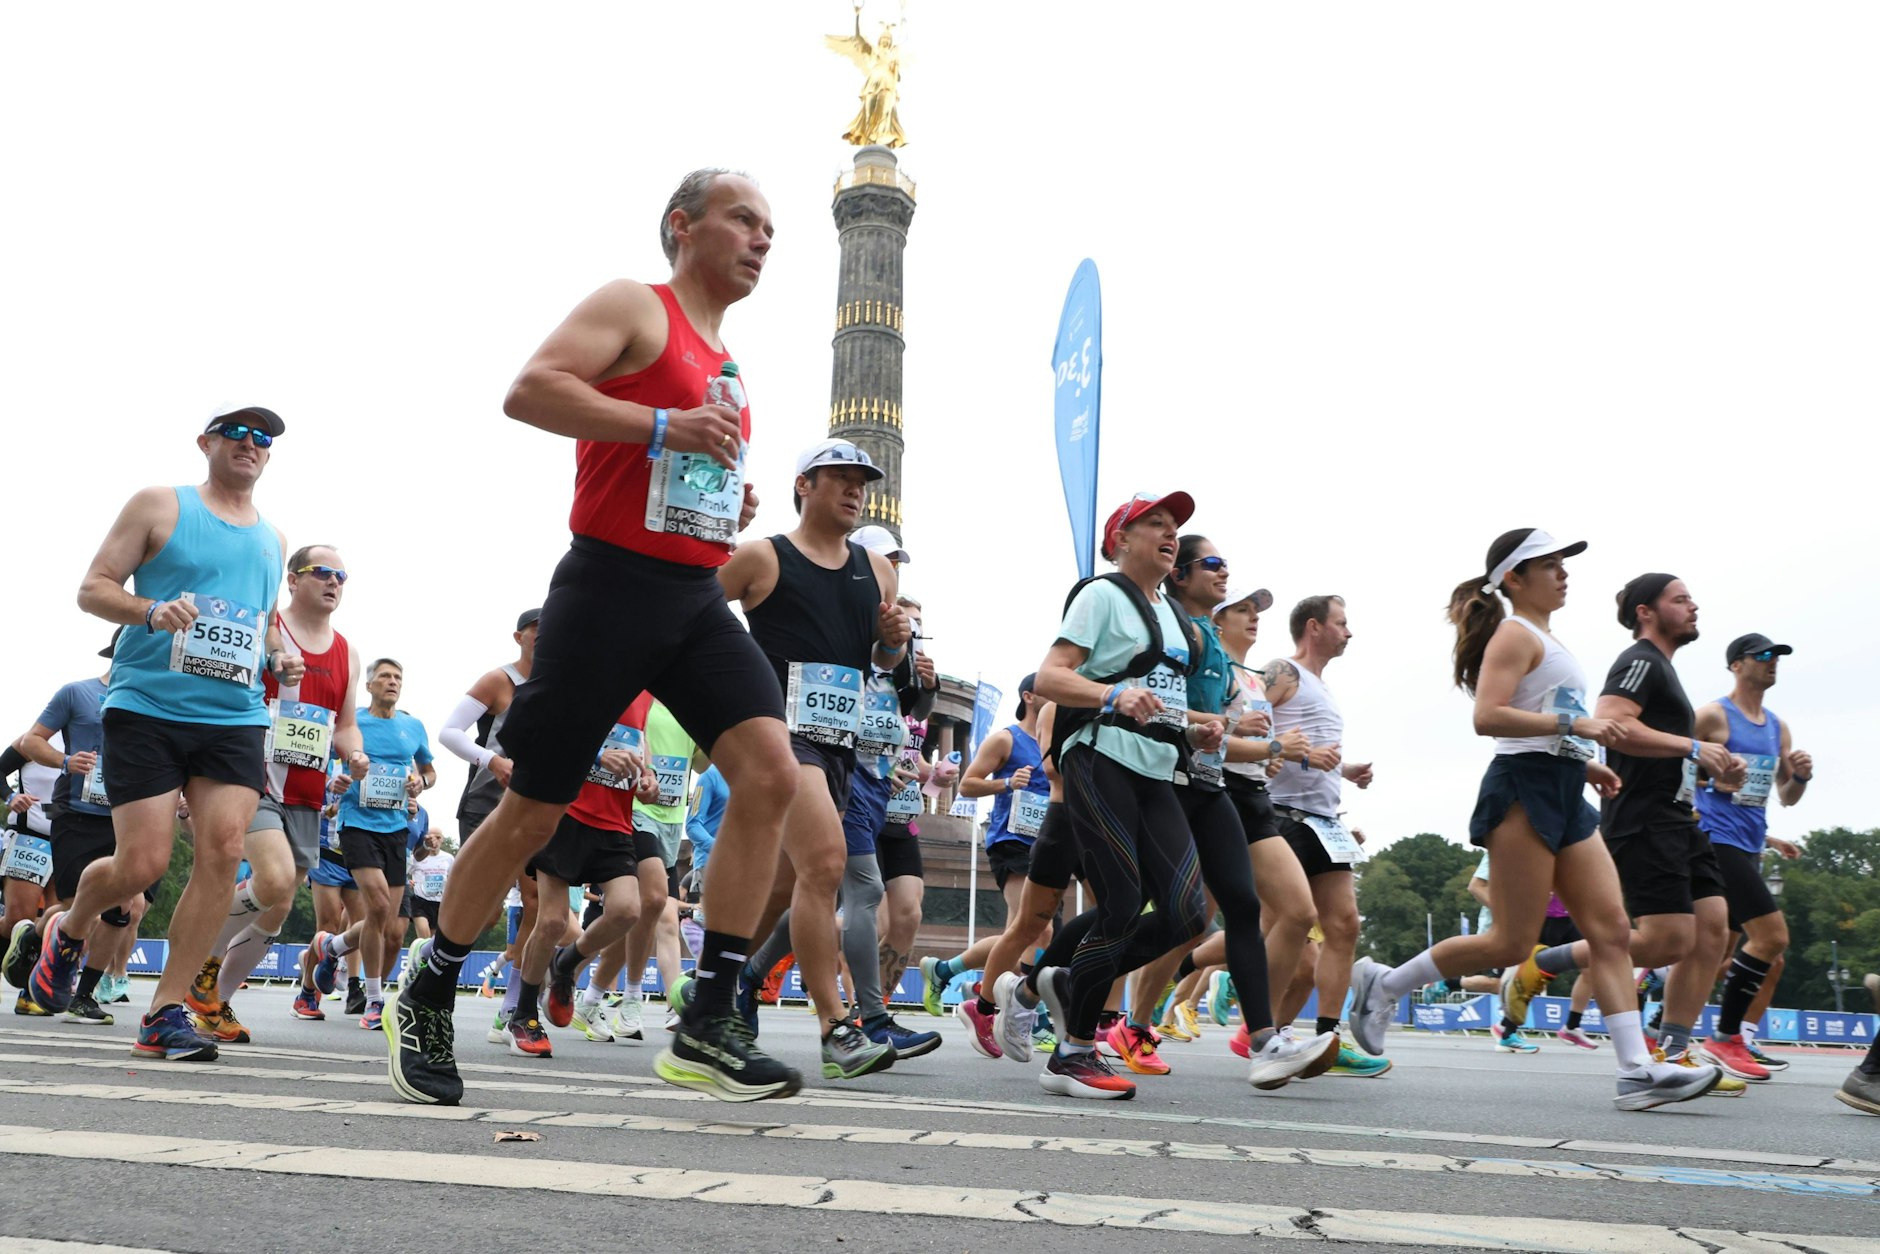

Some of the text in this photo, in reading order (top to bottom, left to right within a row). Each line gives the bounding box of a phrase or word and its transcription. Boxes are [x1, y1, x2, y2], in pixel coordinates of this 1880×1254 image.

[667, 508, 728, 530] IMPOSSIBLE
[666, 520, 727, 541] IS NOTHING
[193, 622, 253, 651] 56332
[210, 646, 237, 660] Mark
[184, 656, 234, 672] IMPOSSIBLE
[183, 664, 231, 680] IS NOTHING
[806, 691, 856, 714] 61587
[811, 712, 849, 727] Sunghyo
[861, 715, 901, 731] 5664
[286, 723, 320, 742] 3461
[798, 725, 840, 737] IMPOSSIBLE
[863, 729, 892, 740] Ebrahim
[290, 740, 315, 752] Henrik
[806, 734, 839, 745] NOTHING
[857, 740, 884, 748] POSSIBLE
[274, 749, 311, 760] IMPOSSIBLE
[281, 757, 309, 767] NOTHING
[590, 769, 616, 781] POSSIBLE
[658, 773, 683, 786] 7755
[372, 777, 402, 789] 26281
[13, 849, 48, 866] 16649
[14, 861, 40, 872] Christian
